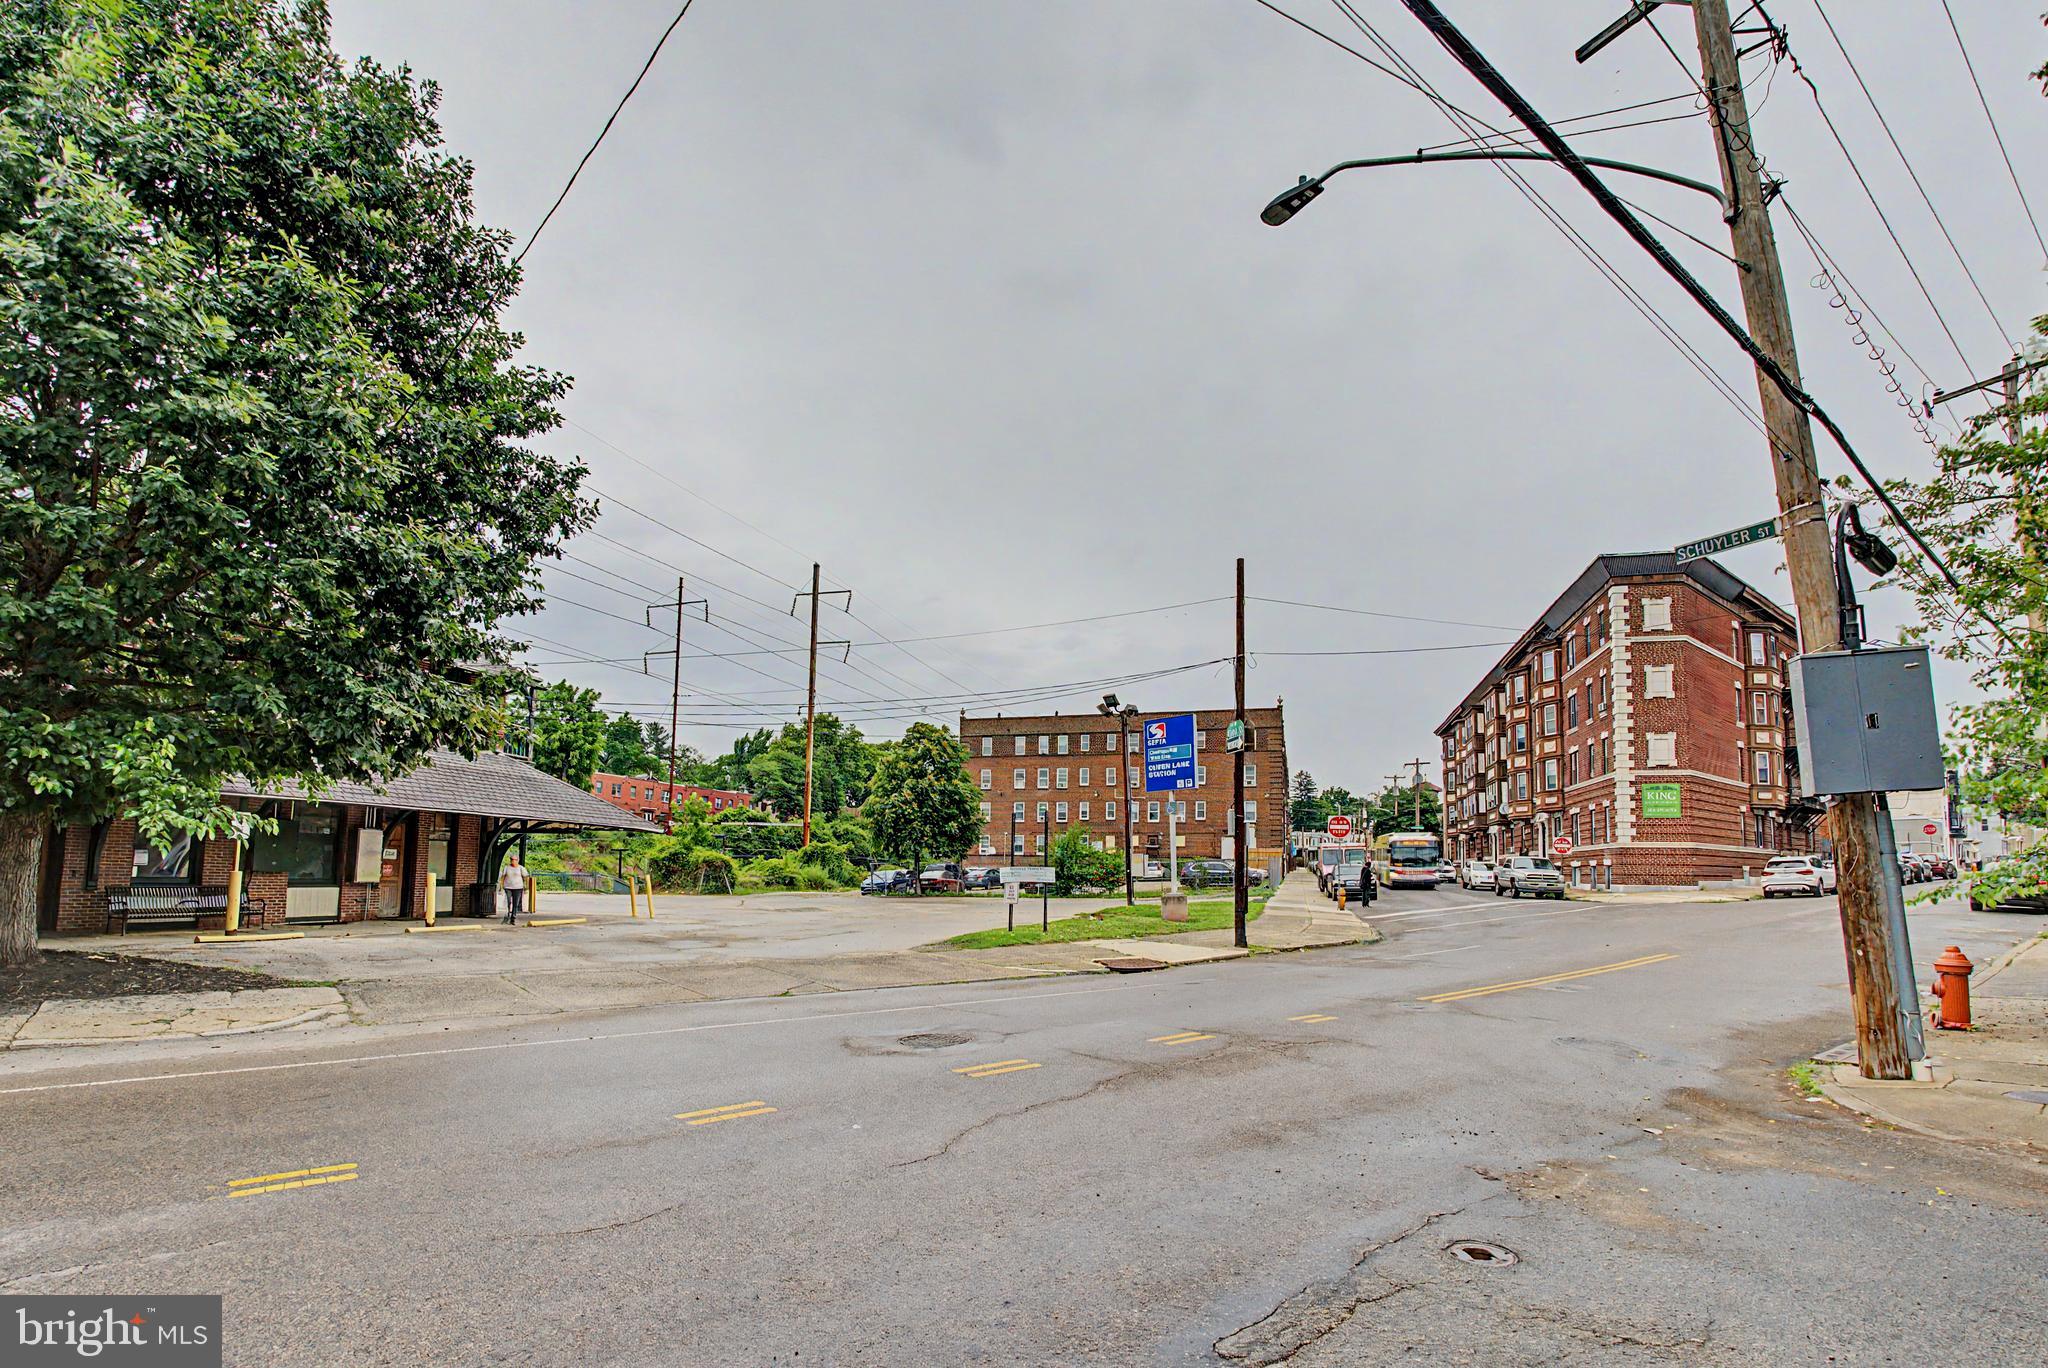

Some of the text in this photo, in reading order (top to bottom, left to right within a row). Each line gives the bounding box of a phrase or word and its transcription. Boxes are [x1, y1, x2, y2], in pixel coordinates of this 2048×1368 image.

[1677, 526, 1770, 560] SCHUYLER ST
[1148, 761, 1190, 771] QUEEN LANE
[1148, 769, 1177, 778] STATION
[1647, 791, 1677, 800] KING
